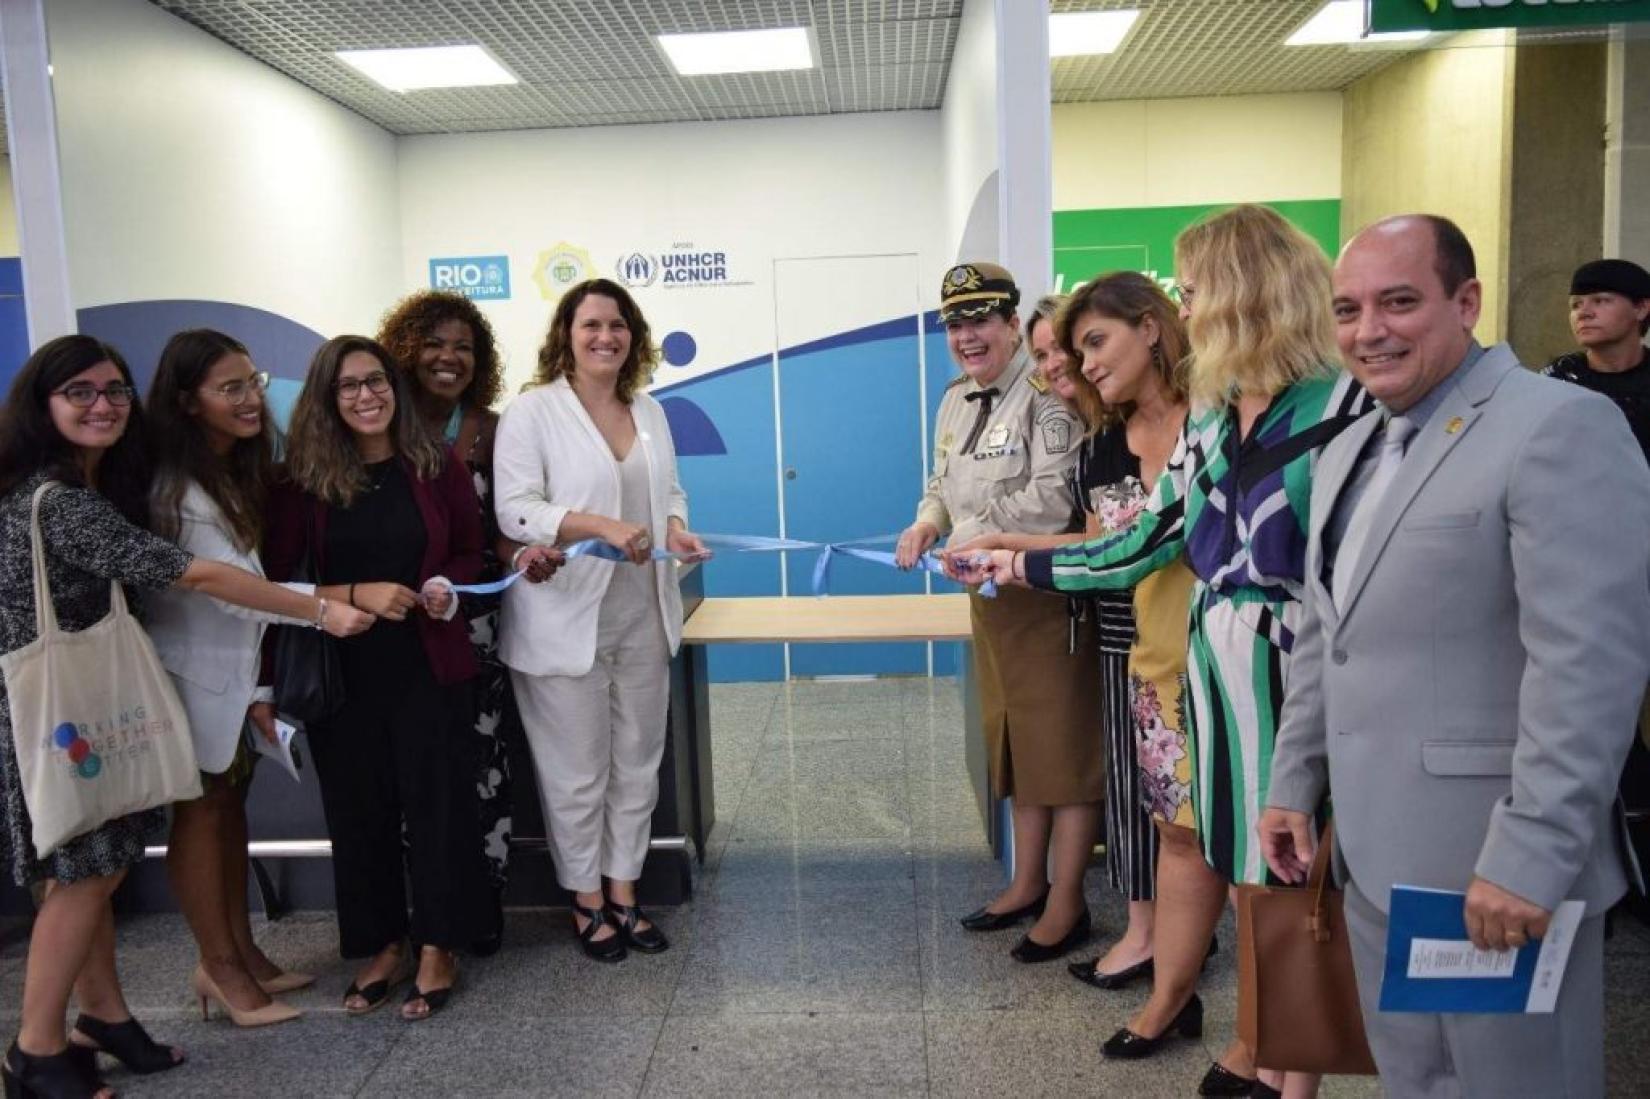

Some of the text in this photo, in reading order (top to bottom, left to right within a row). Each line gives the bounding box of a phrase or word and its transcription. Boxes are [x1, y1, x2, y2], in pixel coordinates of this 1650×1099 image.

[661, 252, 726, 268] UNHCR
[435, 265, 481, 286] RIO
[663, 267, 726, 283] ACNUR
[446, 285, 504, 297] EITURA
[43, 705, 146, 749] RKING
[52, 719, 174, 764] GETHER
[70, 739, 152, 778] TTER
